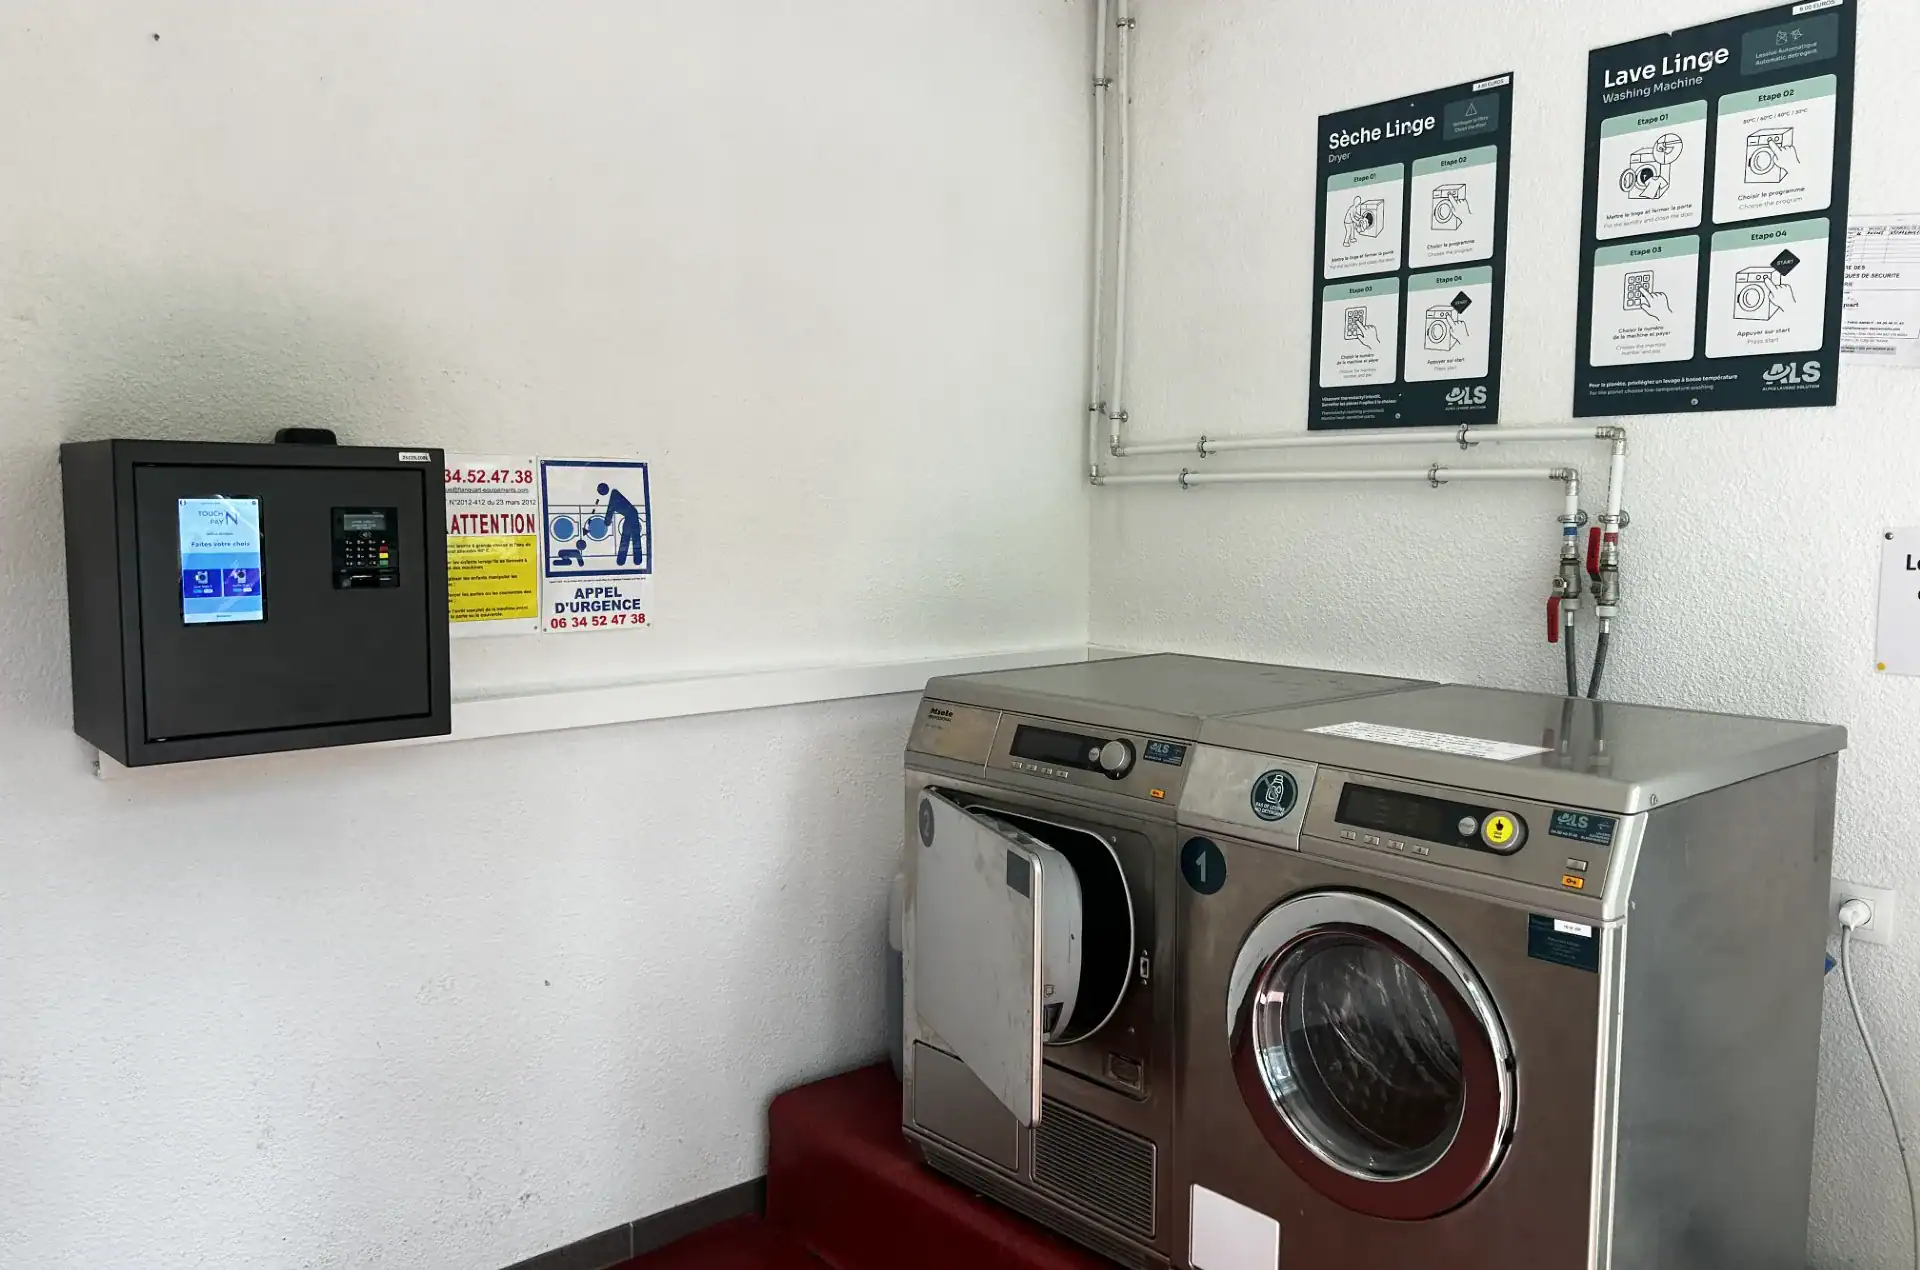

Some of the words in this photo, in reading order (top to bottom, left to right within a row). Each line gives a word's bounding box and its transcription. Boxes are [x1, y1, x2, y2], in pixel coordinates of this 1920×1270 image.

[1604, 64, 1656, 88] Lave
[1662, 47, 1730, 76] Linge
[1755, 55, 1787, 66] Automatic
[1602, 86, 1652, 104] Washing
[1653, 74, 1703, 92] Machine
[1758, 93, 1782, 102] Etape
[1783, 89, 1794, 98] 02
[1637, 116, 1658, 125] Etape
[1328, 127, 1381, 150] Sèche
[1386, 116, 1436, 138] Linge
[1328, 151, 1350, 164] Dryer
[1440, 158, 1457, 167] Etape
[1354, 174, 1370, 182] Etape
[1738, 191, 1759, 201] Choisir
[1760, 190, 1767, 198] le
[1768, 186, 1805, 198] programme
[1751, 232, 1773, 241] Etape
[1775, 230, 1787, 238] 04
[1630, 247, 1650, 257] Etape
[1436, 276, 1452, 284] Etape
[1702, 374, 1738, 383] température
[1762, 360, 1821, 385] ALS
[1446, 386, 1488, 406] ALS
[451, 514, 535, 534] ATTENTION
[574, 587, 622, 599] APPEL
[555, 599, 641, 614] D'URGENCE
[551, 618, 567, 629] 06
[572, 617, 588, 627] 34
[592, 615, 607, 626] 52
[612, 614, 626, 624] 47
[631, 613, 646, 624] 38
[930, 708, 954, 717] Miele
[923, 810, 930, 837] 2
[1557, 813, 1589, 828] ALS
[1196, 850, 1207, 882] 1
